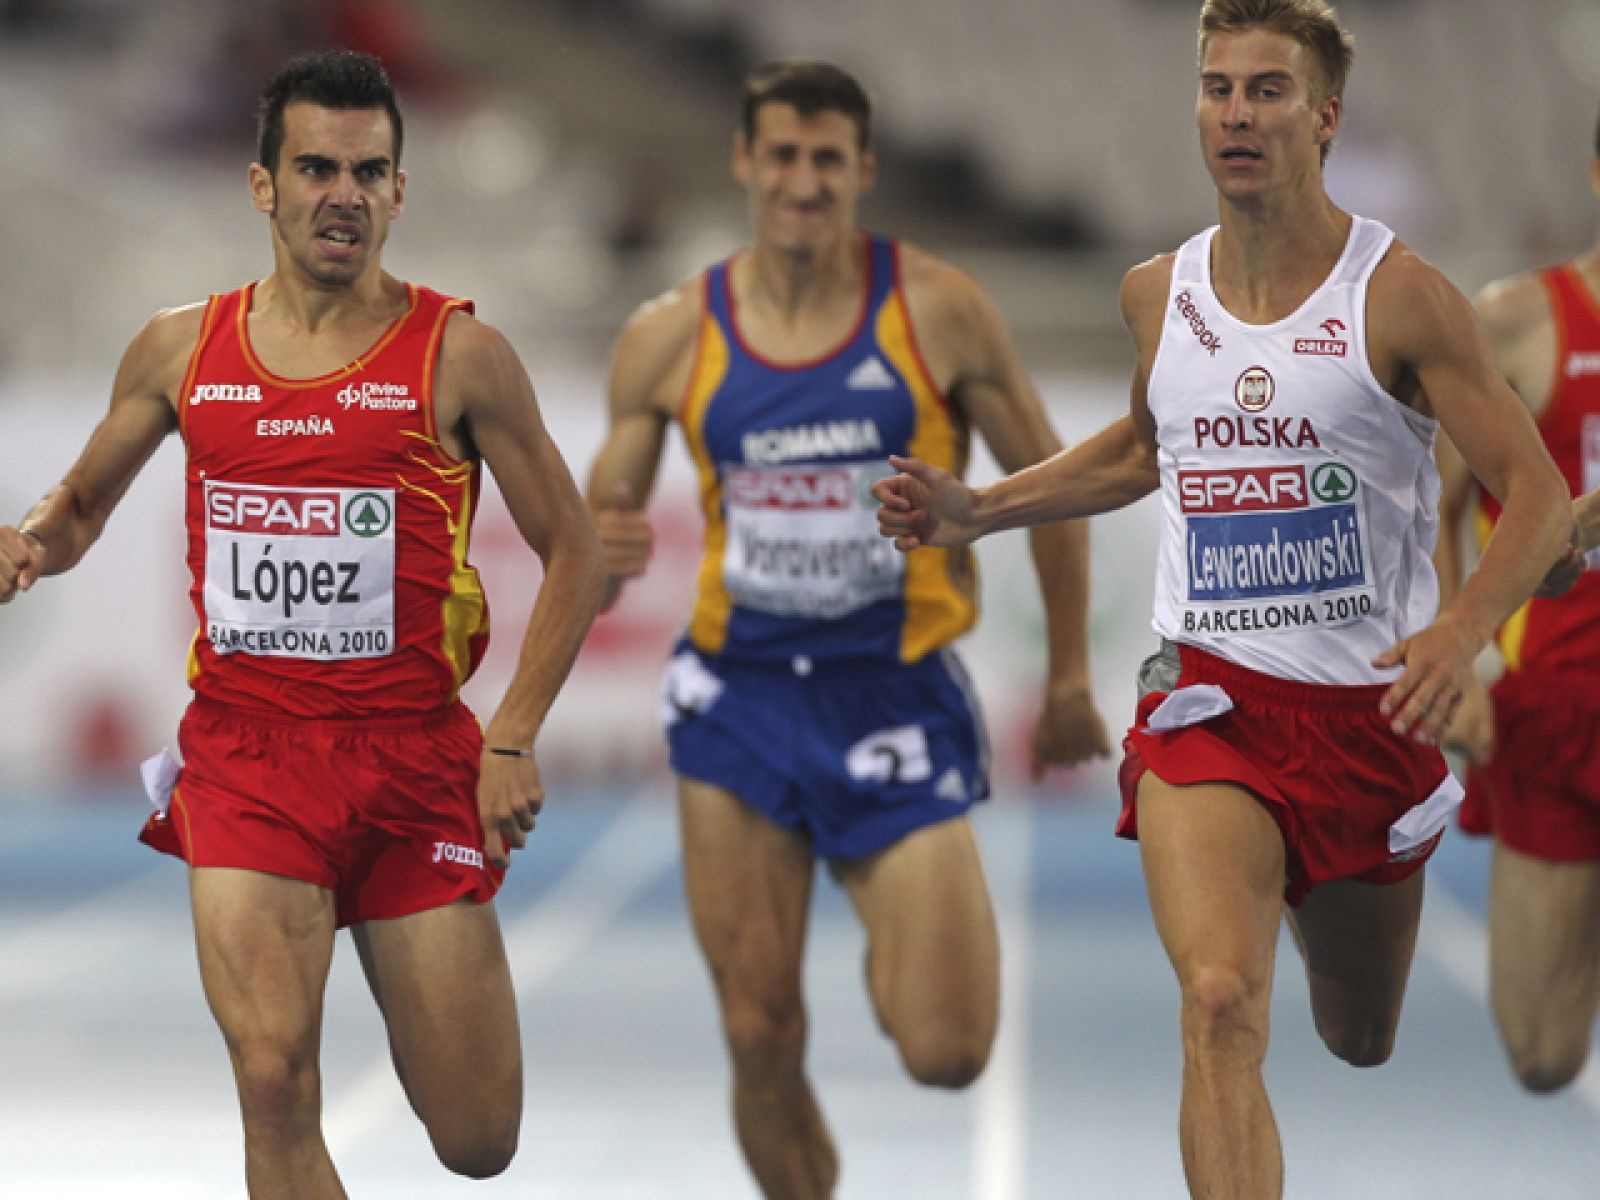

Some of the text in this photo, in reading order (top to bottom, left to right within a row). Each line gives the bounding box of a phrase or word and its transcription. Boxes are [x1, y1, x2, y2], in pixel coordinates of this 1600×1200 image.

[1176, 289, 1222, 357] Reebok
[1297, 341, 1343, 354] ORLEN
[361, 396, 417, 410] Pastora
[362, 382, 408, 396] Divina
[256, 415, 335, 436] ESPAÑA
[742, 420, 880, 464] ROMANIA
[1194, 417, 1320, 449] POLSKA
[728, 471, 849, 505] SPAR
[1181, 472, 1305, 507] SPAR
[211, 493, 336, 530] SPAR
[1190, 517, 1361, 591] Lewandowski
[232, 542, 361, 618] López
[1184, 594, 1371, 632] BARCELONA 2010
[210, 624, 387, 654] BARCELONA 2010
